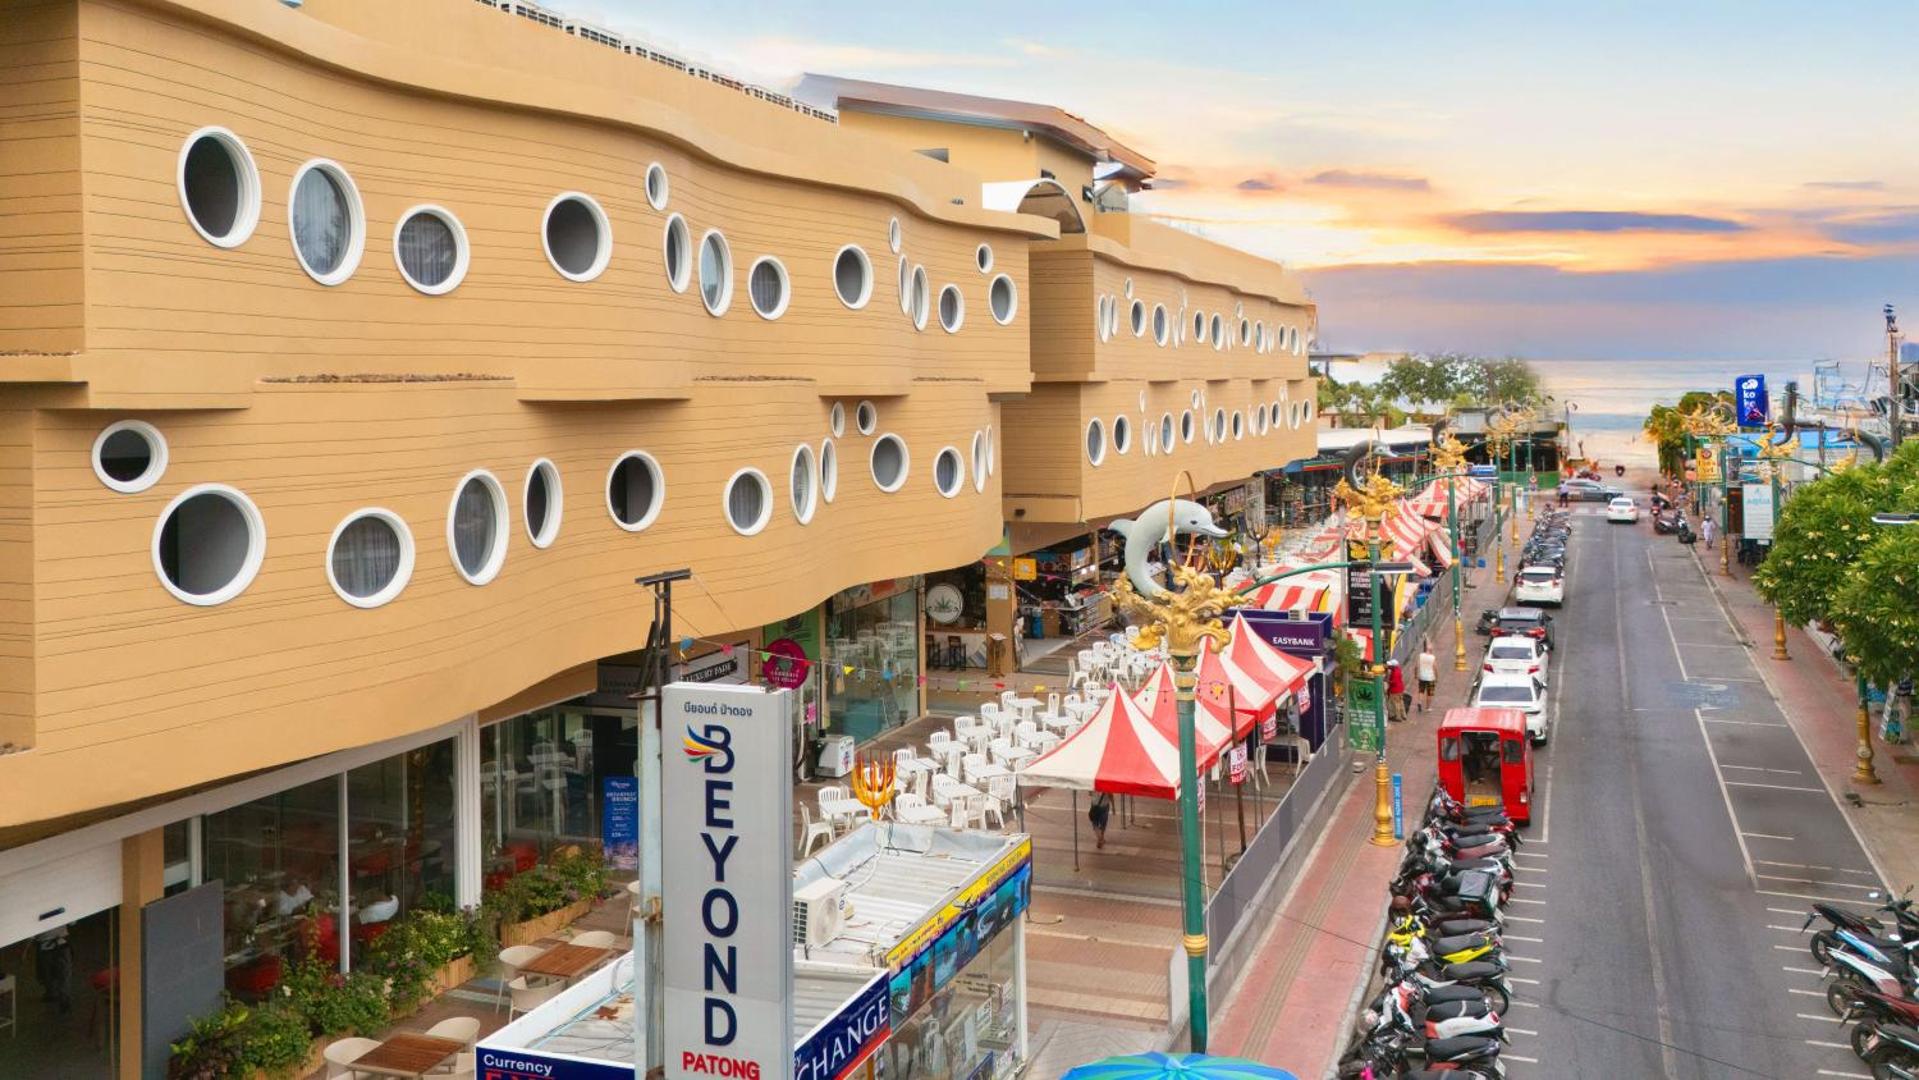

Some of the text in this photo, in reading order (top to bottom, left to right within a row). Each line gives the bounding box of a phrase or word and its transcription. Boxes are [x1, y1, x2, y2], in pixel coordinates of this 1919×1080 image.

[1272, 636, 1315, 647] EASYBANK
[700, 724, 740, 1047] BEYOND
[483, 1053, 553, 1076] Currency
[682, 1051, 760, 1080] PATONG
